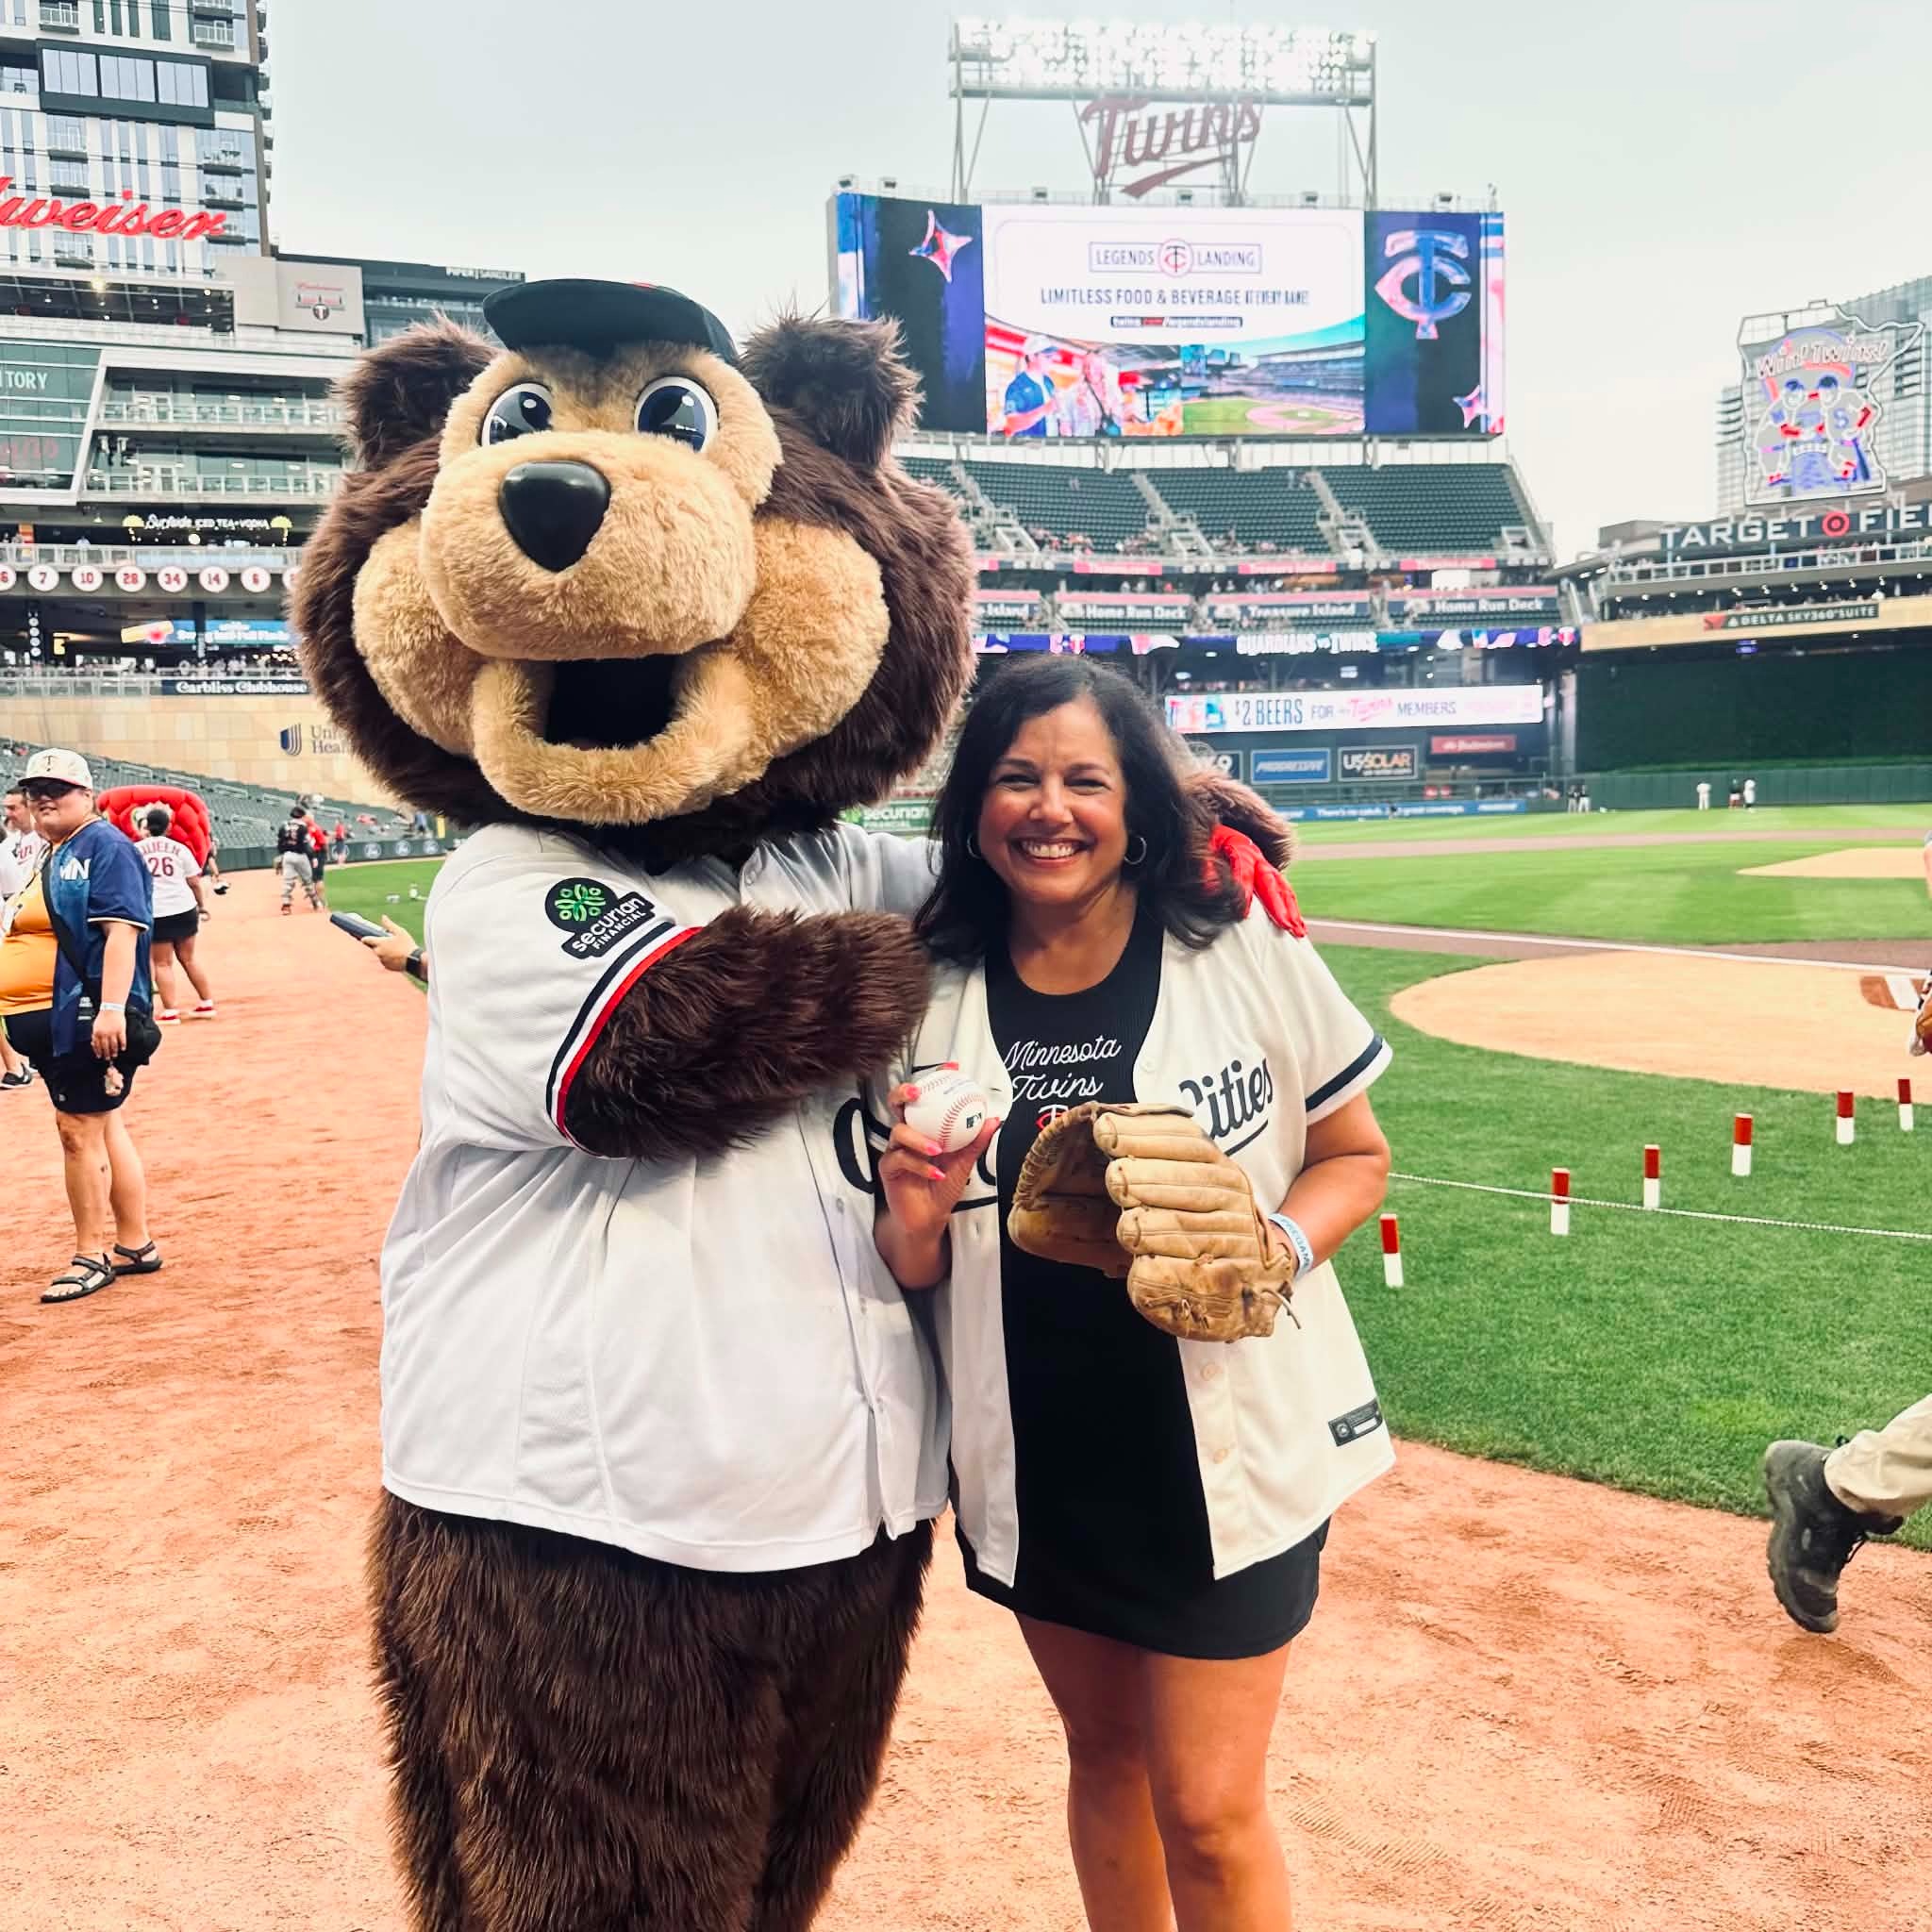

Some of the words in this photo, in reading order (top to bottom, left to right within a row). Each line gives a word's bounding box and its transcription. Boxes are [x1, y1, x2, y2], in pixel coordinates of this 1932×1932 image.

[1080, 93, 1260, 179] Twins
[1095, 249, 1155, 265] LEGENDS
[1197, 250, 1256, 267] LANDING
[1040, 288, 1112, 306] LIMITLESS
[1116, 288, 1153, 306] FOOD
[1157, 289, 1167, 305] &
[1171, 289, 1241, 306] BEVERAGE
[1658, 515, 1816, 550] TARGET
[39, 572, 47, 584] 7
[80, 572, 94, 584] 10
[164, 573, 181, 585] 34
[207, 573, 222, 585] 14
[1086, 605, 1124, 620] Home
[1125, 605, 1151, 620] Run
[1153, 605, 1187, 620] Deck
[1247, 605, 1309, 618] Treasure
[1312, 603, 1356, 616] Island
[1435, 599, 1475, 613] Home
[1478, 598, 1507, 612] Run
[1509, 596, 1543, 610] Deck
[1740, 611, 1785, 626] DELTA
[1840, 605, 1875, 619] SUITE
[1236, 633, 1317, 655] GUARDIANS
[1329, 632, 1380, 654] TWINS
[236, 680, 308, 694] Clubhouse
[1256, 698, 1304, 725] BEERS
[1311, 704, 1334, 719] FOR
[1396, 701, 1457, 716] MEMBERS
[148, 856, 174, 877] 26
[571, 897, 646, 953] securian
[592, 910, 647, 950] FINANCIAL
[1003, 1035, 1123, 1071] Minnesota
[1011, 1072, 1104, 1103] Twins
